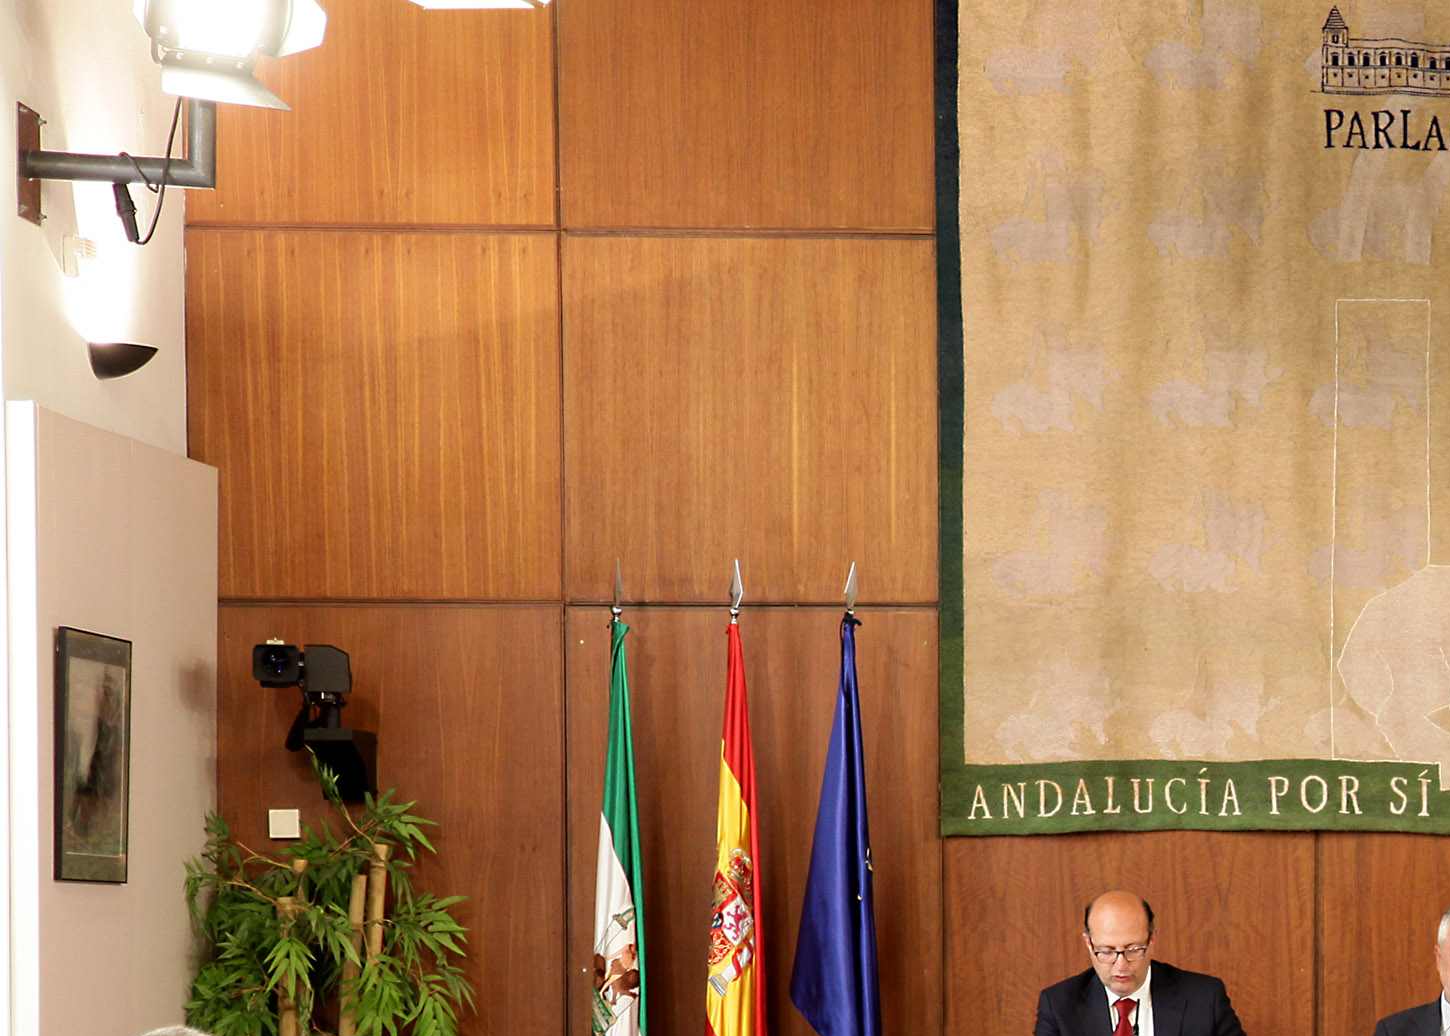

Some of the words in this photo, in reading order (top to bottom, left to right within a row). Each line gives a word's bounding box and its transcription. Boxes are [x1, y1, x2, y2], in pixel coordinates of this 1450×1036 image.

[967, 767, 1243, 820] ANDALUCÍA
[1268, 774, 1364, 816] POR
[1389, 769, 1433, 817] SÍ
